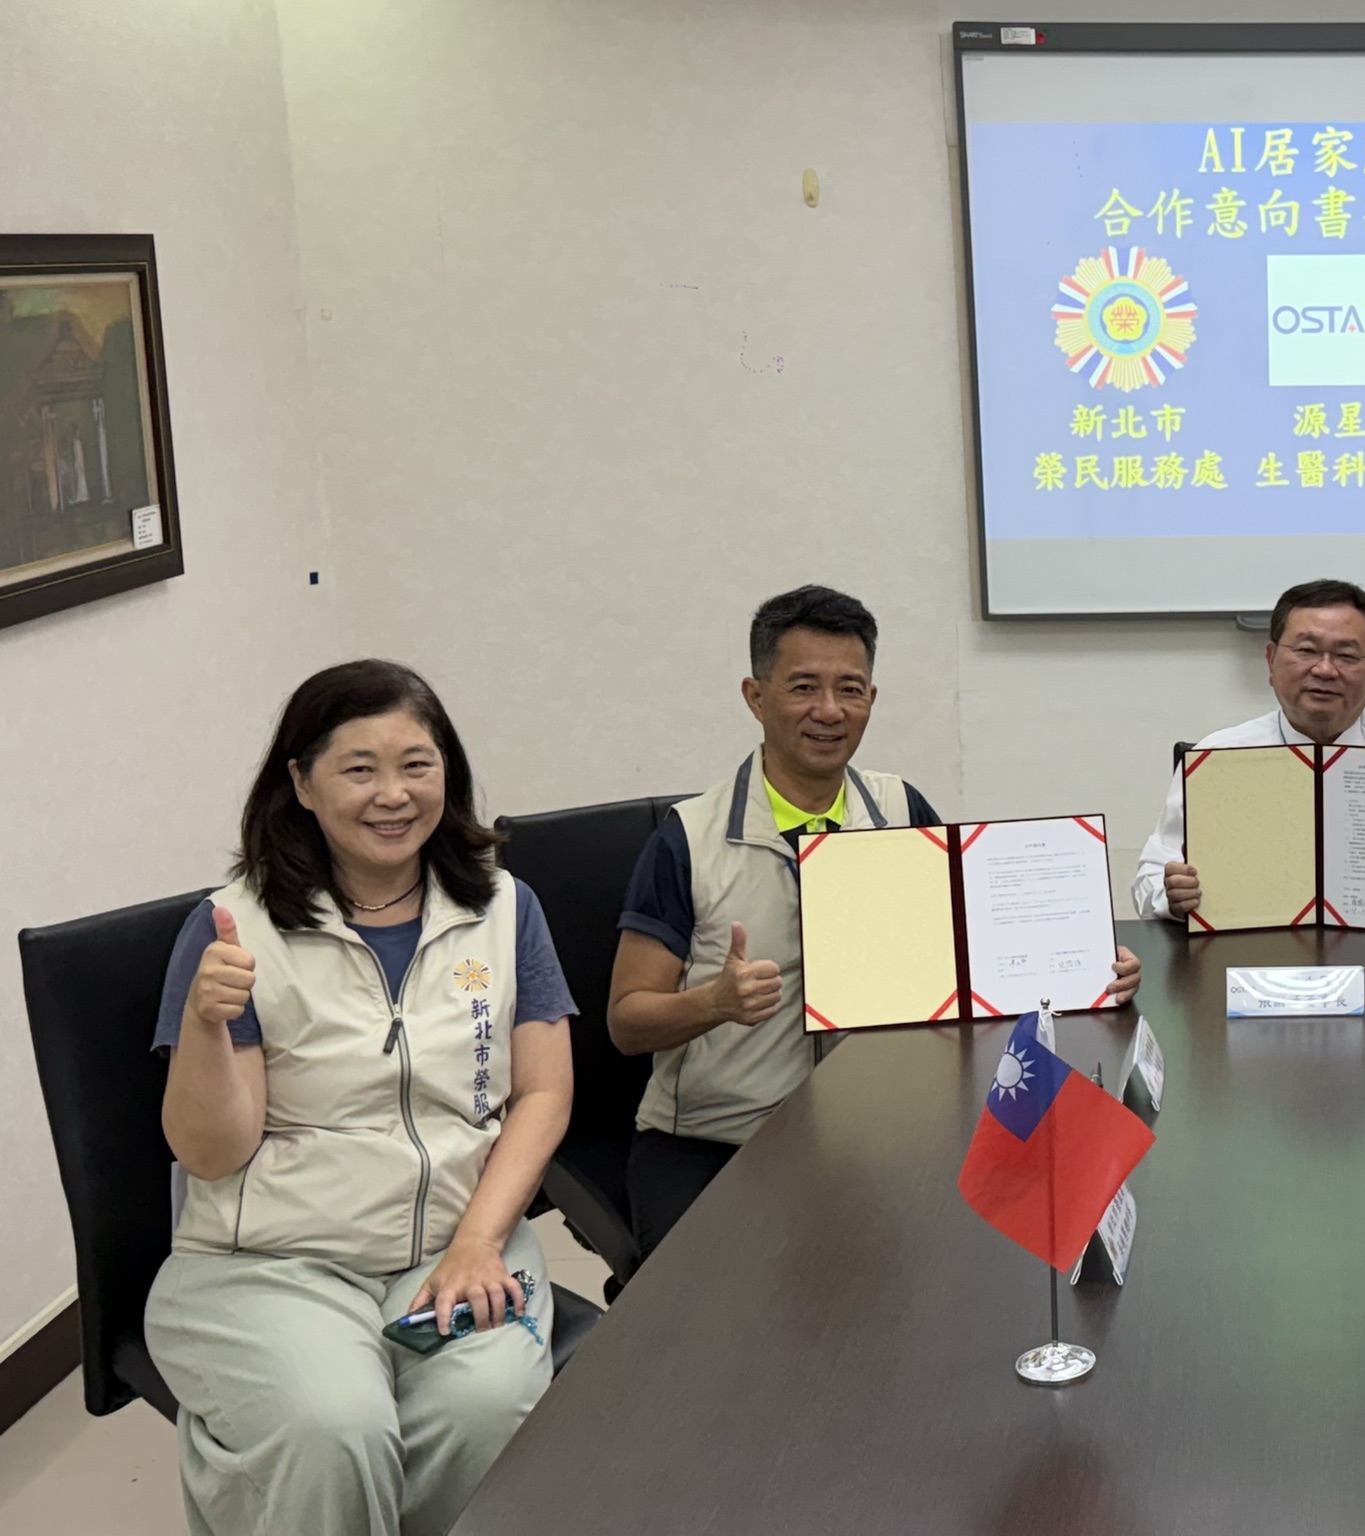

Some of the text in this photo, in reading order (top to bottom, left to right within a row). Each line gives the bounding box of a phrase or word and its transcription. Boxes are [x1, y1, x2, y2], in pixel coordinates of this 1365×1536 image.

[1070, 404, 1187, 441] 新北市
[1032, 449, 1229, 491] 榮民服務處
